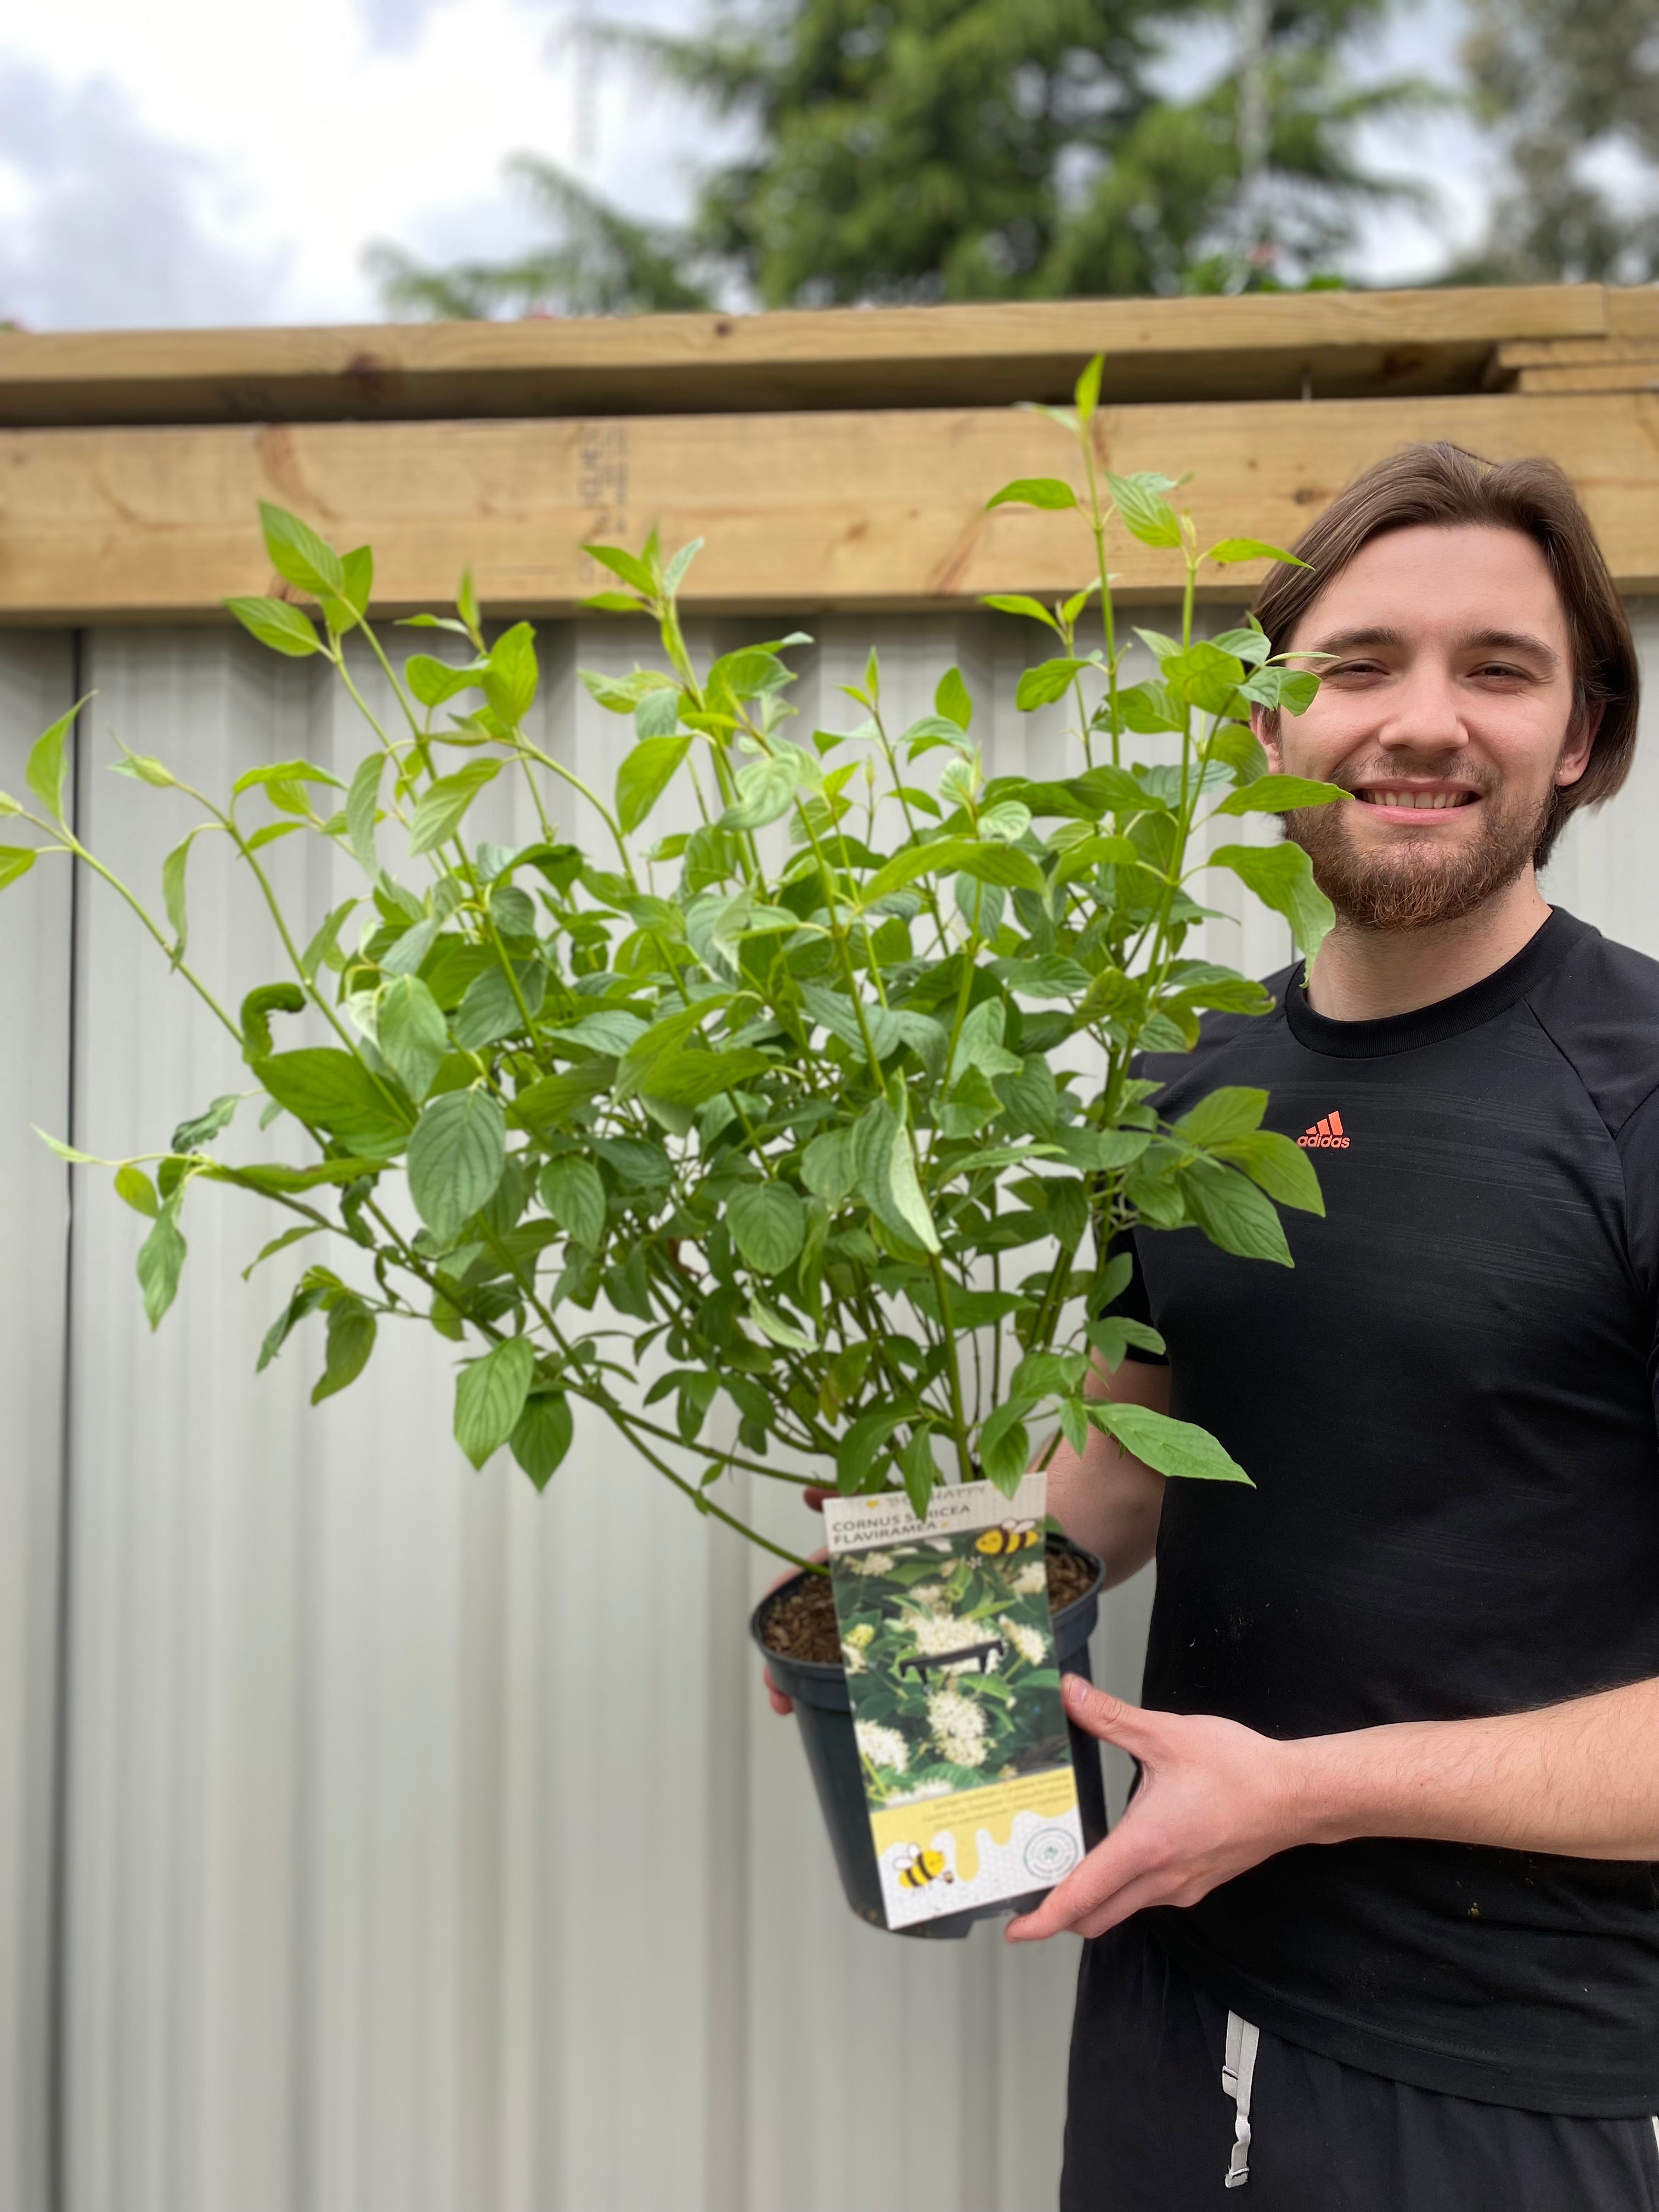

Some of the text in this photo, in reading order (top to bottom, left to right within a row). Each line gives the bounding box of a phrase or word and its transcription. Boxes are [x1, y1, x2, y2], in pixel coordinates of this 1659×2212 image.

[1297, 1134, 1350, 1148] adidas
[832, 1504, 970, 1533] CORNUS SRICEA
[833, 1521, 936, 1545] FLAVIRAMEA
